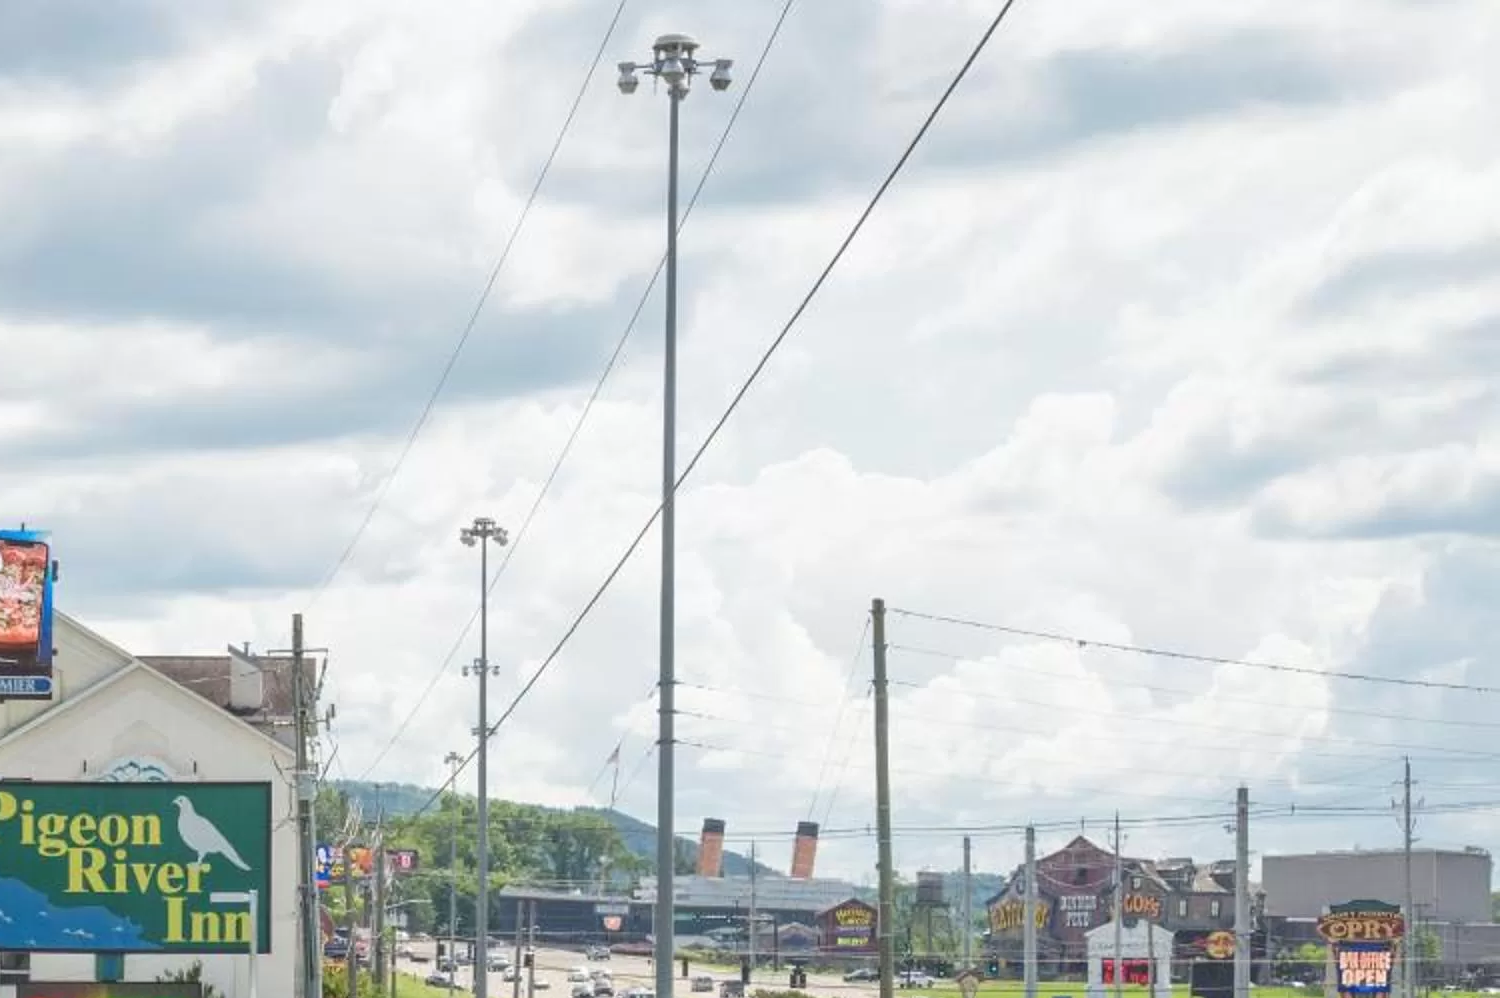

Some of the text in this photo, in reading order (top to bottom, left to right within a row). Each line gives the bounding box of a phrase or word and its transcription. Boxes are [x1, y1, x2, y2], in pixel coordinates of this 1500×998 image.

[63, 848, 211, 893] River
[163, 896, 252, 943] Inn
[1329, 919, 1398, 939] OPRY
[1341, 969, 1387, 987] OPEN
